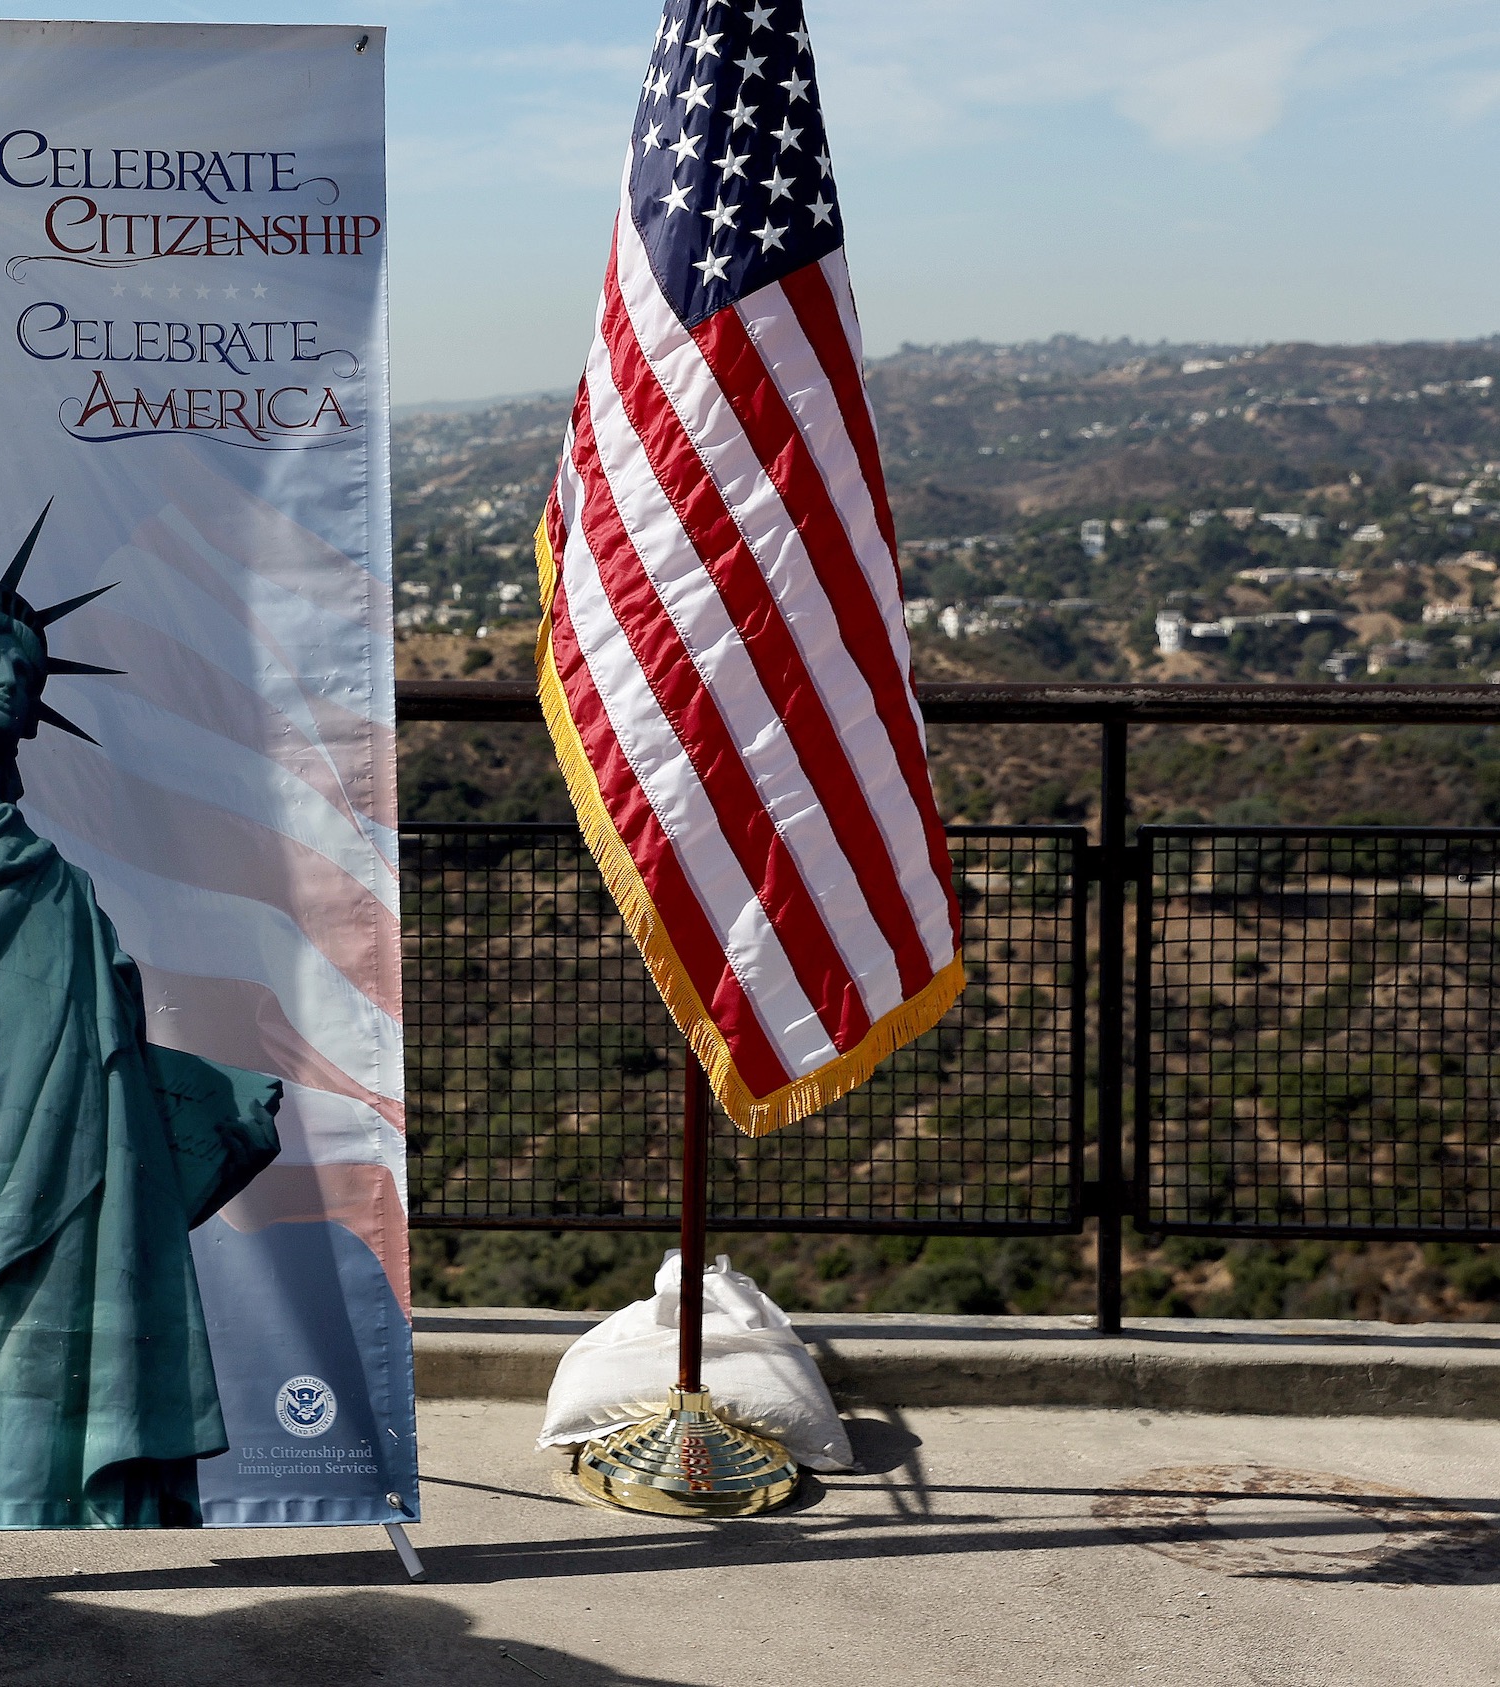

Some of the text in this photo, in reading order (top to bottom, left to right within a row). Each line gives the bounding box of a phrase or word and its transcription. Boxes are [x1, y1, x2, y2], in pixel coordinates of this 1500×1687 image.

[44, 195, 382, 262] CITIZENSHIP
[15, 301, 360, 378] CELEBRATE
[60, 370, 363, 450] AMERICA
[278, 1409, 335, 1435] HOMELAND SECURITY
[237, 1462, 379, 1478] Immigration Services
[243, 1446, 373, 1461] U.S. Citizenship and
